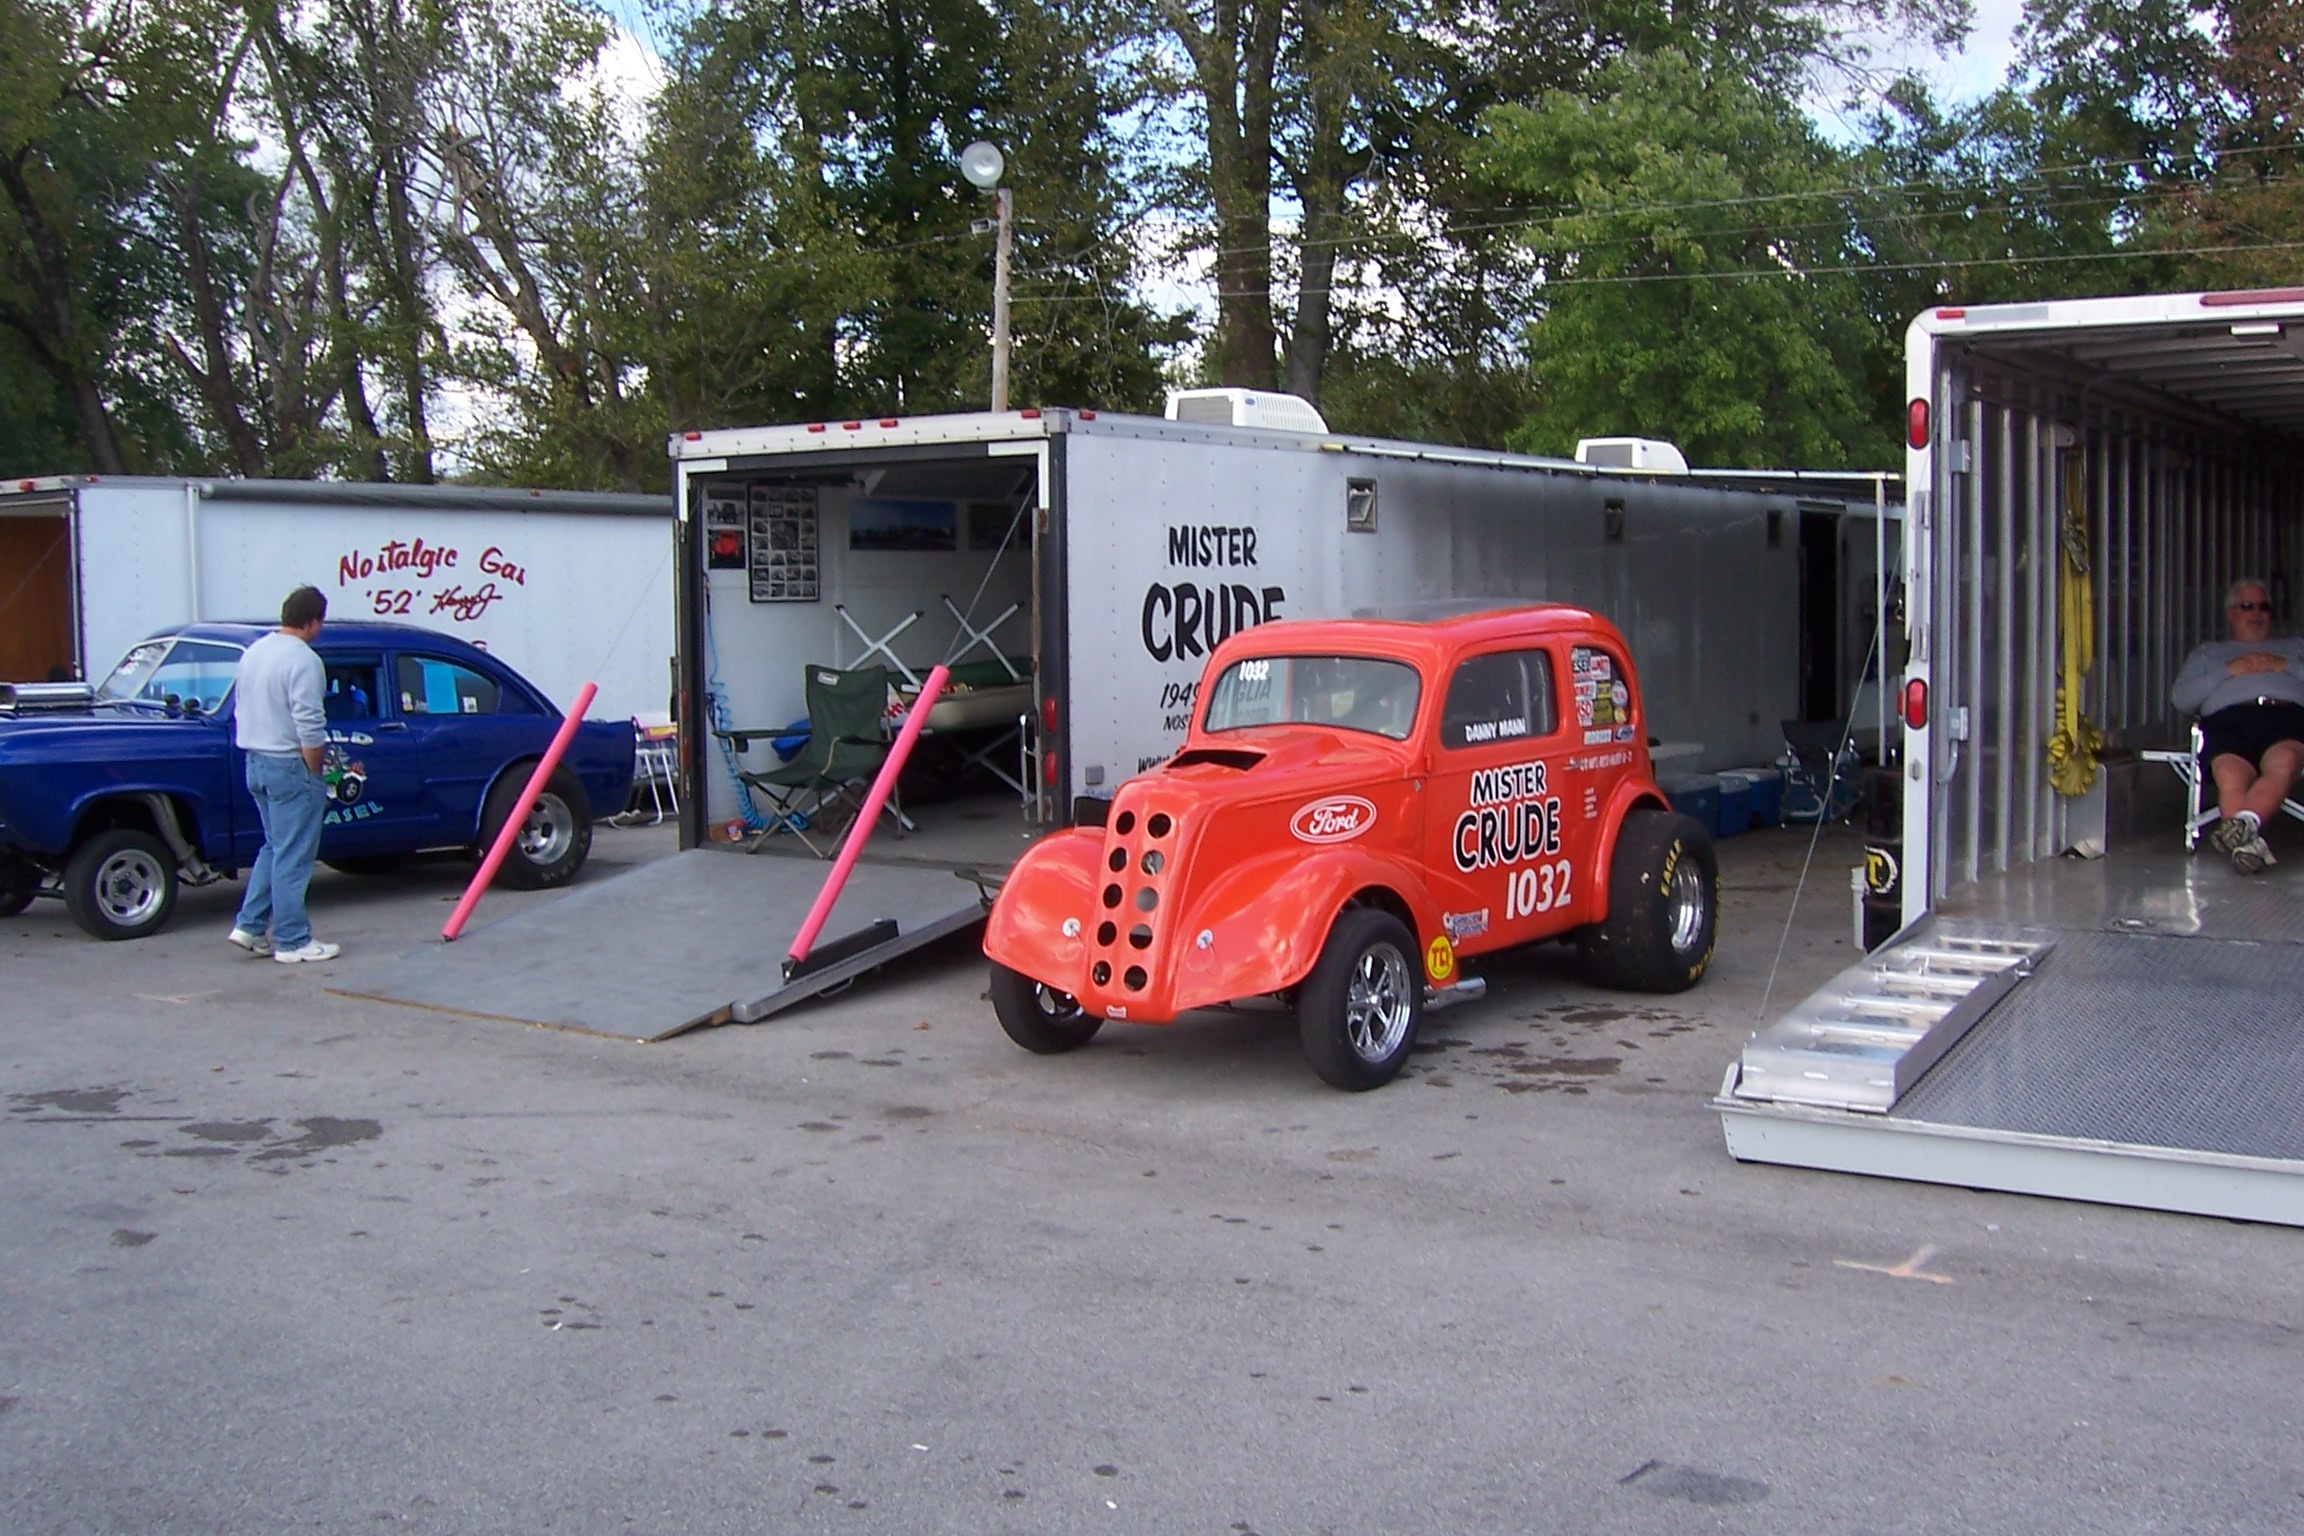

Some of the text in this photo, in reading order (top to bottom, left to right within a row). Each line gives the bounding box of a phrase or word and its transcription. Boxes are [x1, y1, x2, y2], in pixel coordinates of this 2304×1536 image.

[339, 537, 526, 587] Nostalgic Gas
[1168, 525, 1258, 568] MISTER
[1142, 582, 1286, 663] CRUDE
[1238, 660, 1270, 681] 1032
[1464, 717, 1526, 742] DANNY MANN
[1471, 761, 1547, 806] MISTER
[323, 800, 384, 826] ASEL
[1309, 804, 1359, 835] Ford
[1454, 797, 1561, 873] CRUDE
[1505, 858, 1572, 920] 1032
[1660, 838, 1683, 897] EAGLE
[1432, 946, 1450, 968] TCI
